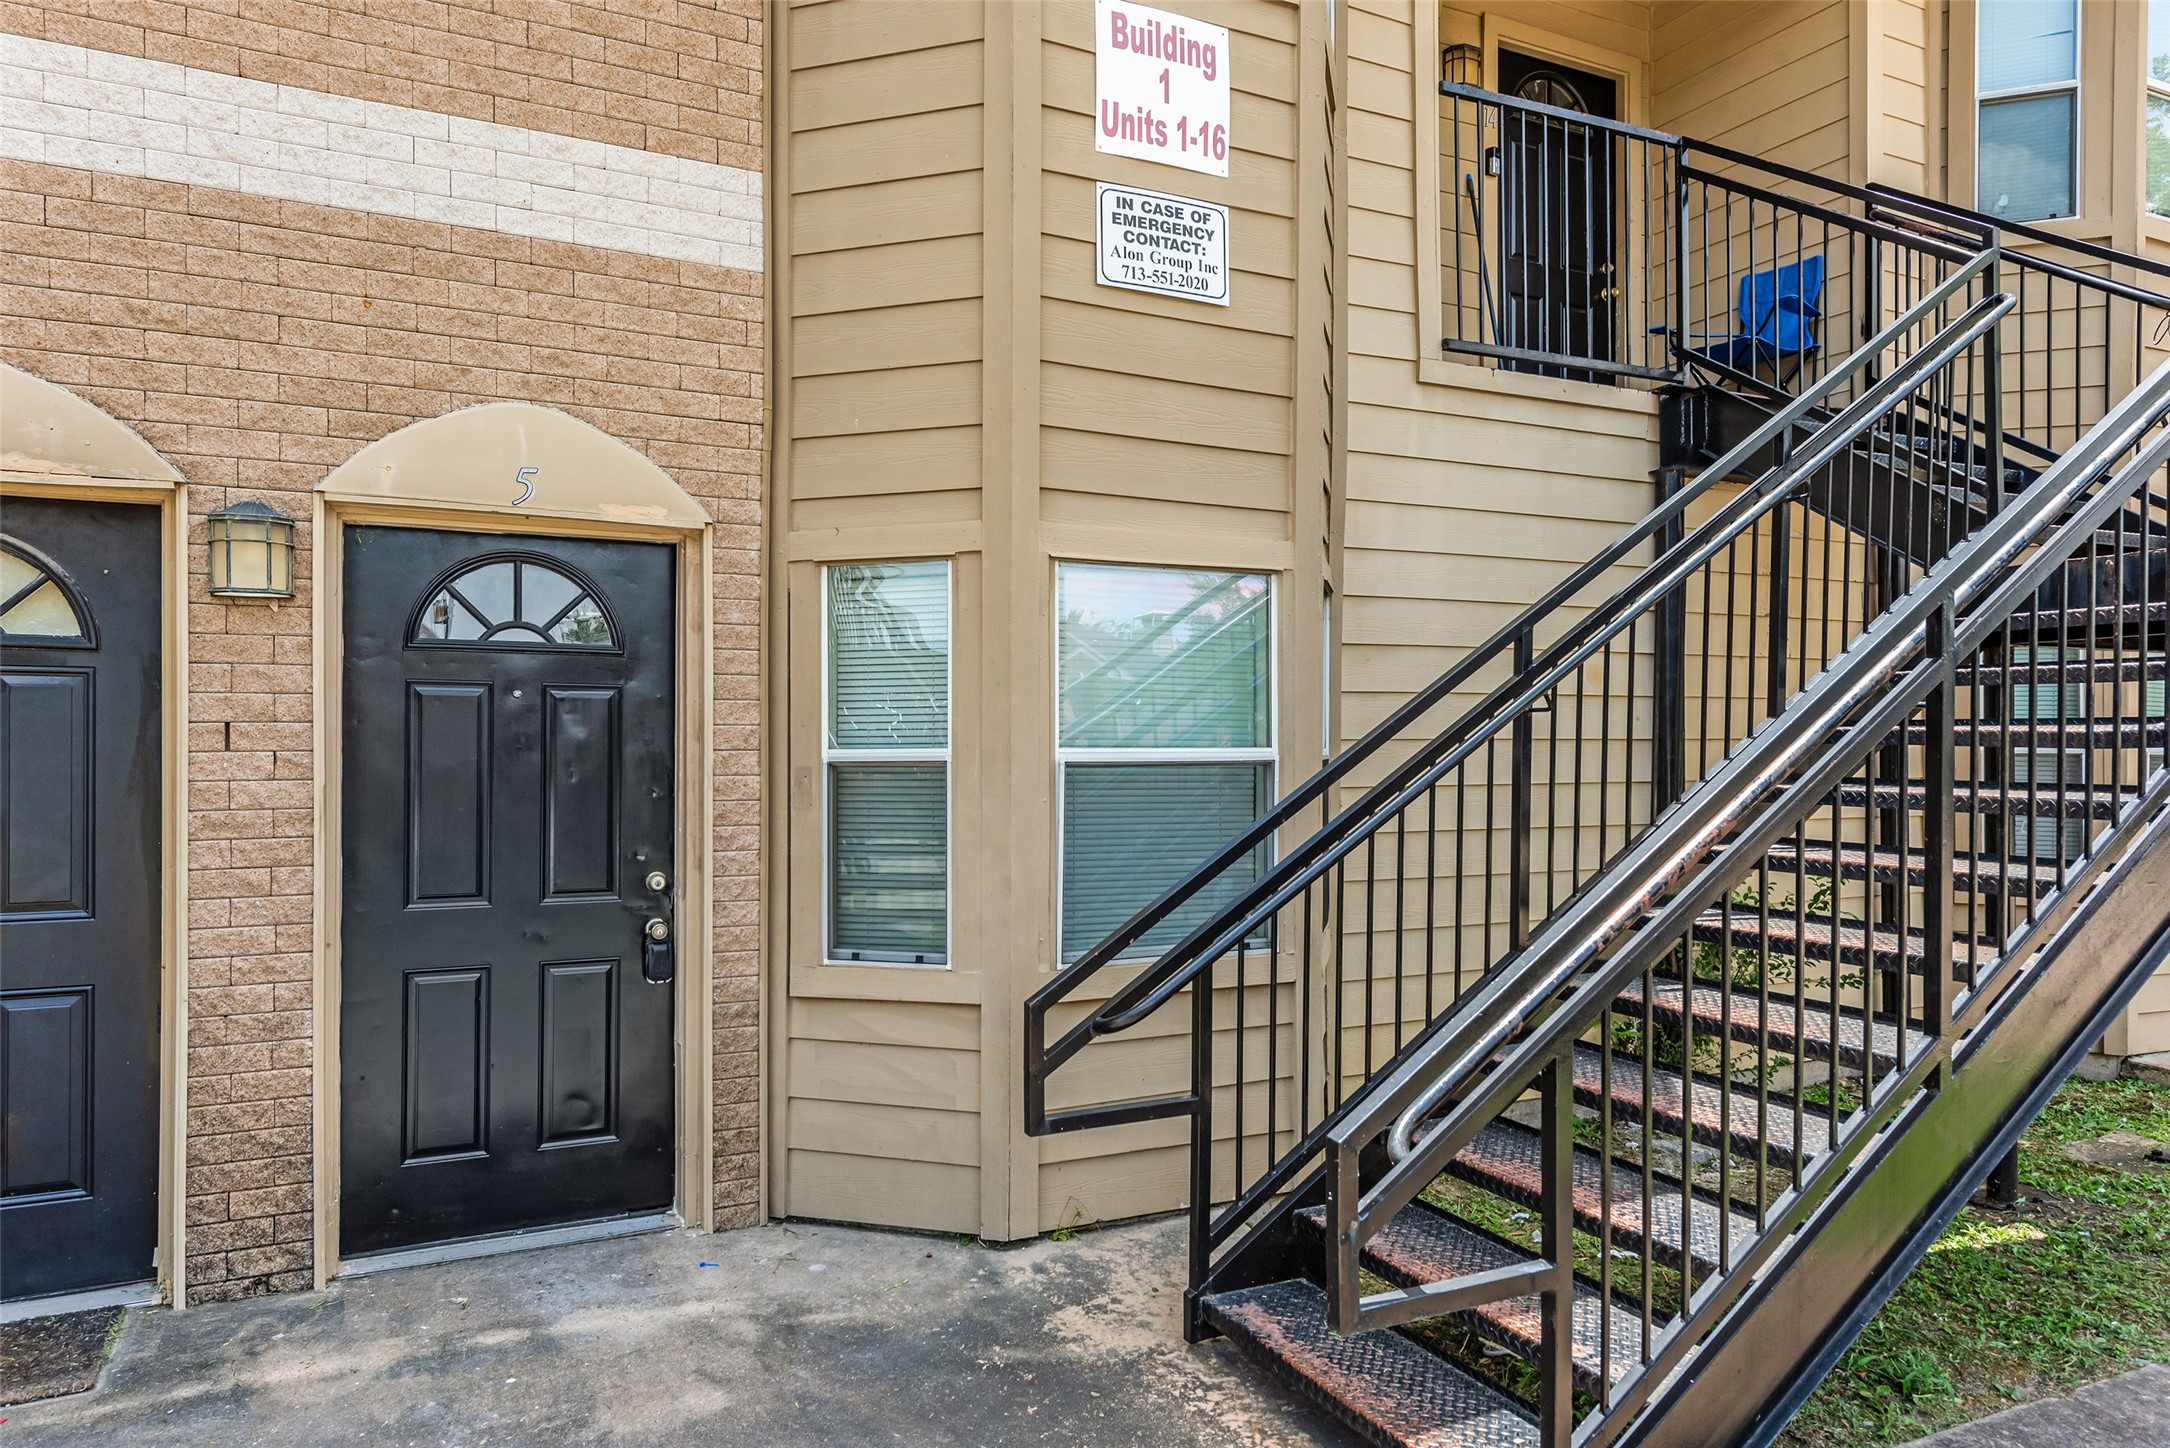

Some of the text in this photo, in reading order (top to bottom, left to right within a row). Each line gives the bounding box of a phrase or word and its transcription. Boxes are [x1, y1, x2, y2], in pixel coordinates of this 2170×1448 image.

[1111, 10, 1217, 82] Building
[1159, 67, 1170, 104] 1
[1101, 98, 1226, 161] Units 1-16
[1116, 196, 1211, 225] IN CASE OF
[1111, 211, 1215, 242] EMERGENCY
[1123, 230, 1206, 256] CONTACT:
[1110, 245, 1219, 275] Alon Group Inc
[1121, 264, 1209, 292] 713-551-2020
[512, 467, 538, 505] 5
